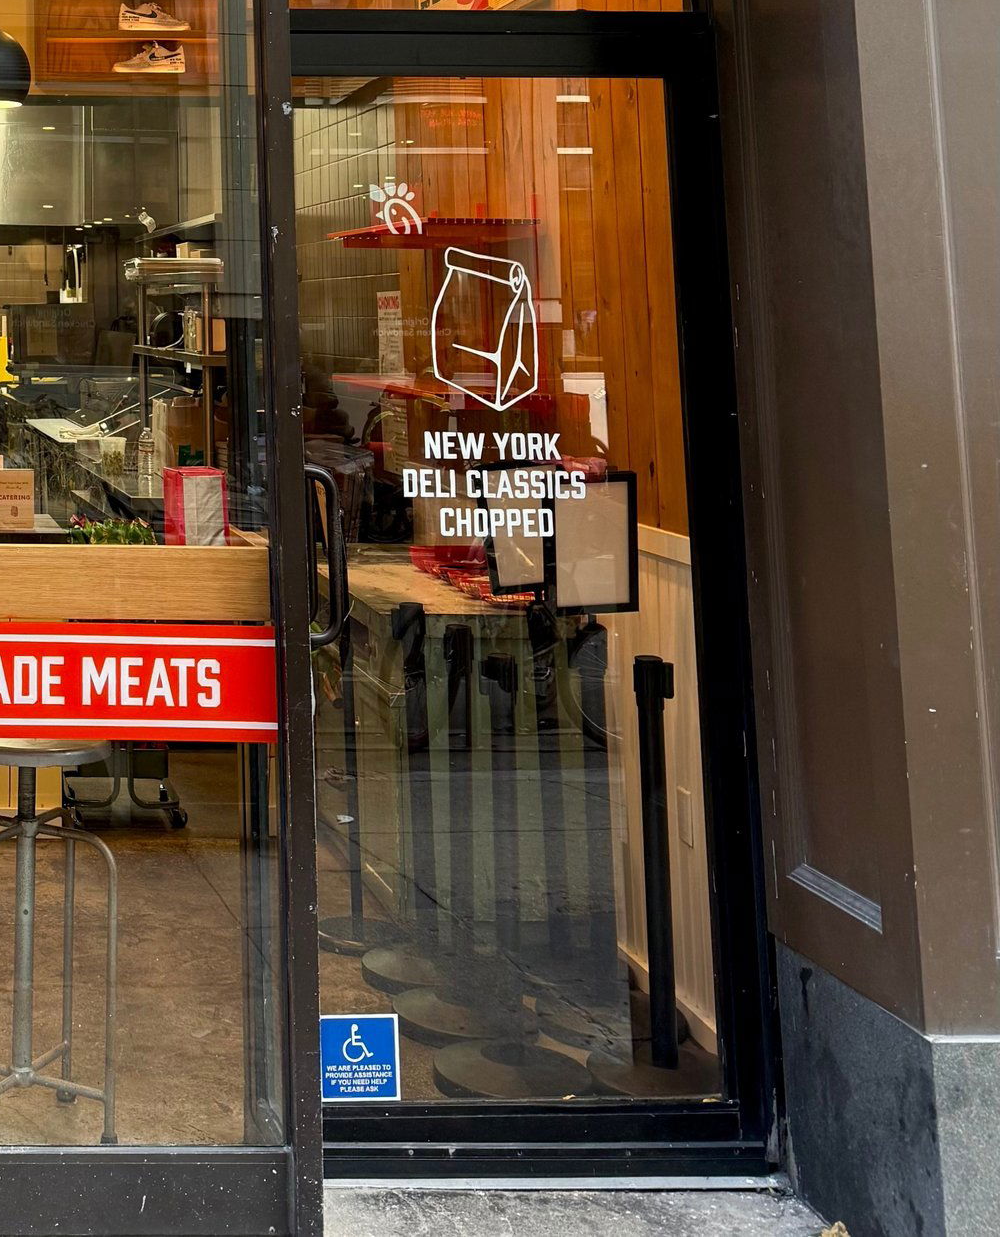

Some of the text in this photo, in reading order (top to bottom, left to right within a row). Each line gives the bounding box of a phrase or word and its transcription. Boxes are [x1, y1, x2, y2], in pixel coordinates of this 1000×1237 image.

[423, 430, 562, 461] NEW YORK
[402, 468, 587, 499] DELI CLASSICS
[439, 507, 555, 538] CHOPPED
[81, 655, 221, 709] MEATS
